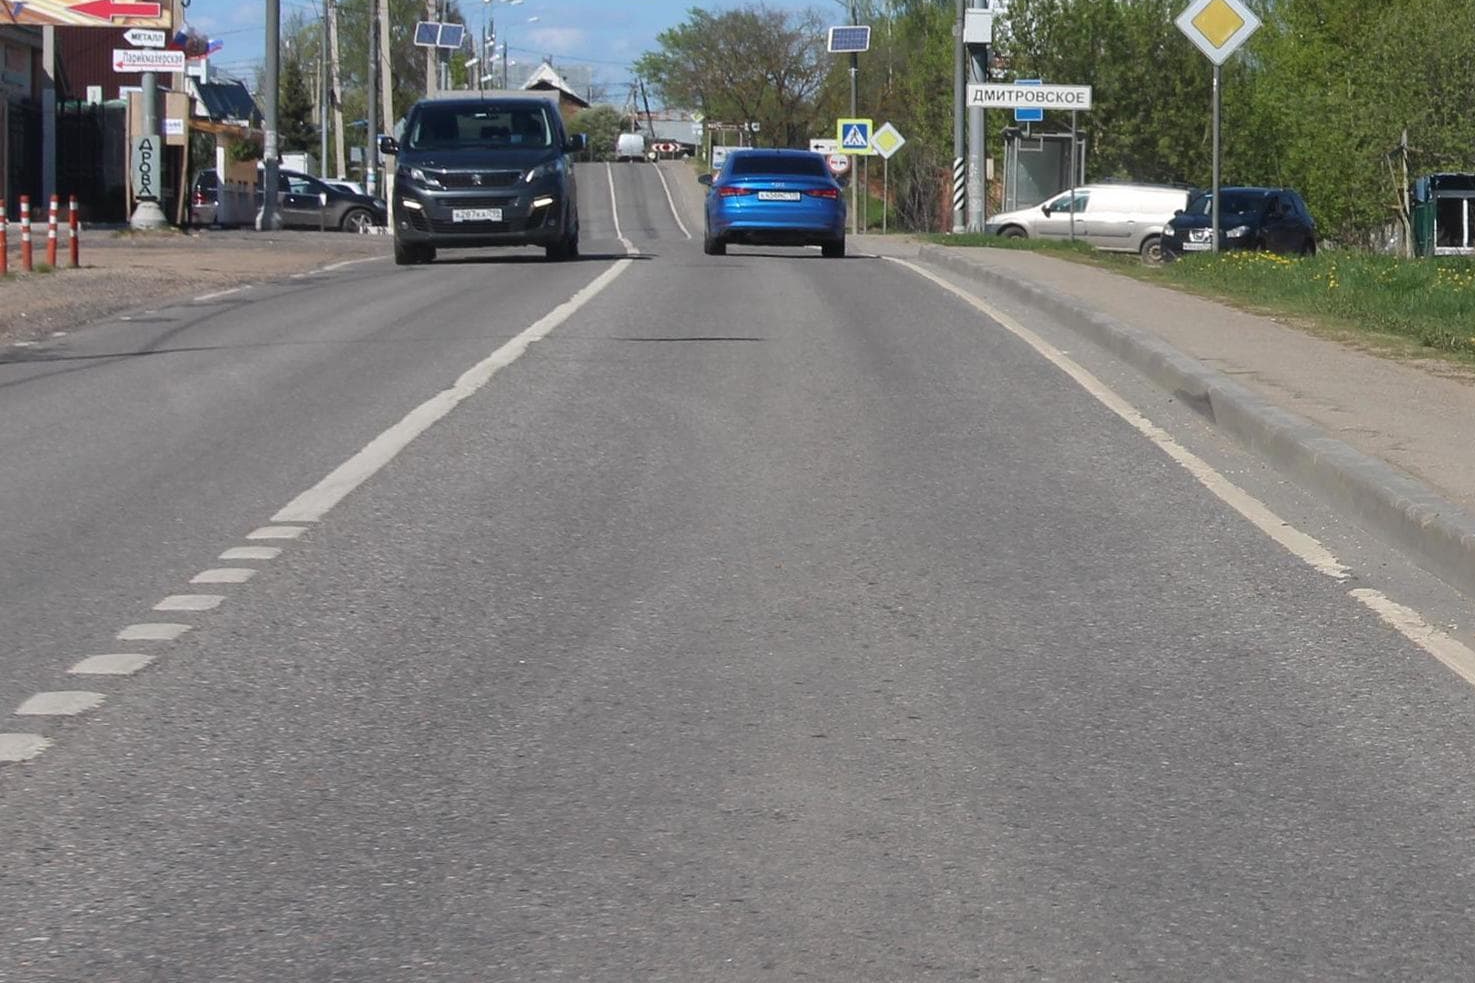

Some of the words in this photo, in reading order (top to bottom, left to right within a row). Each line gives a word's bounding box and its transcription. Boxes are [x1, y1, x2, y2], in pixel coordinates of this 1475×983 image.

[131, 32, 163, 42] МЕТАЛЛ
[973, 89, 1086, 104] ДМИТРОВСКОЕ
[139, 138, 153, 195] ДРОВА
